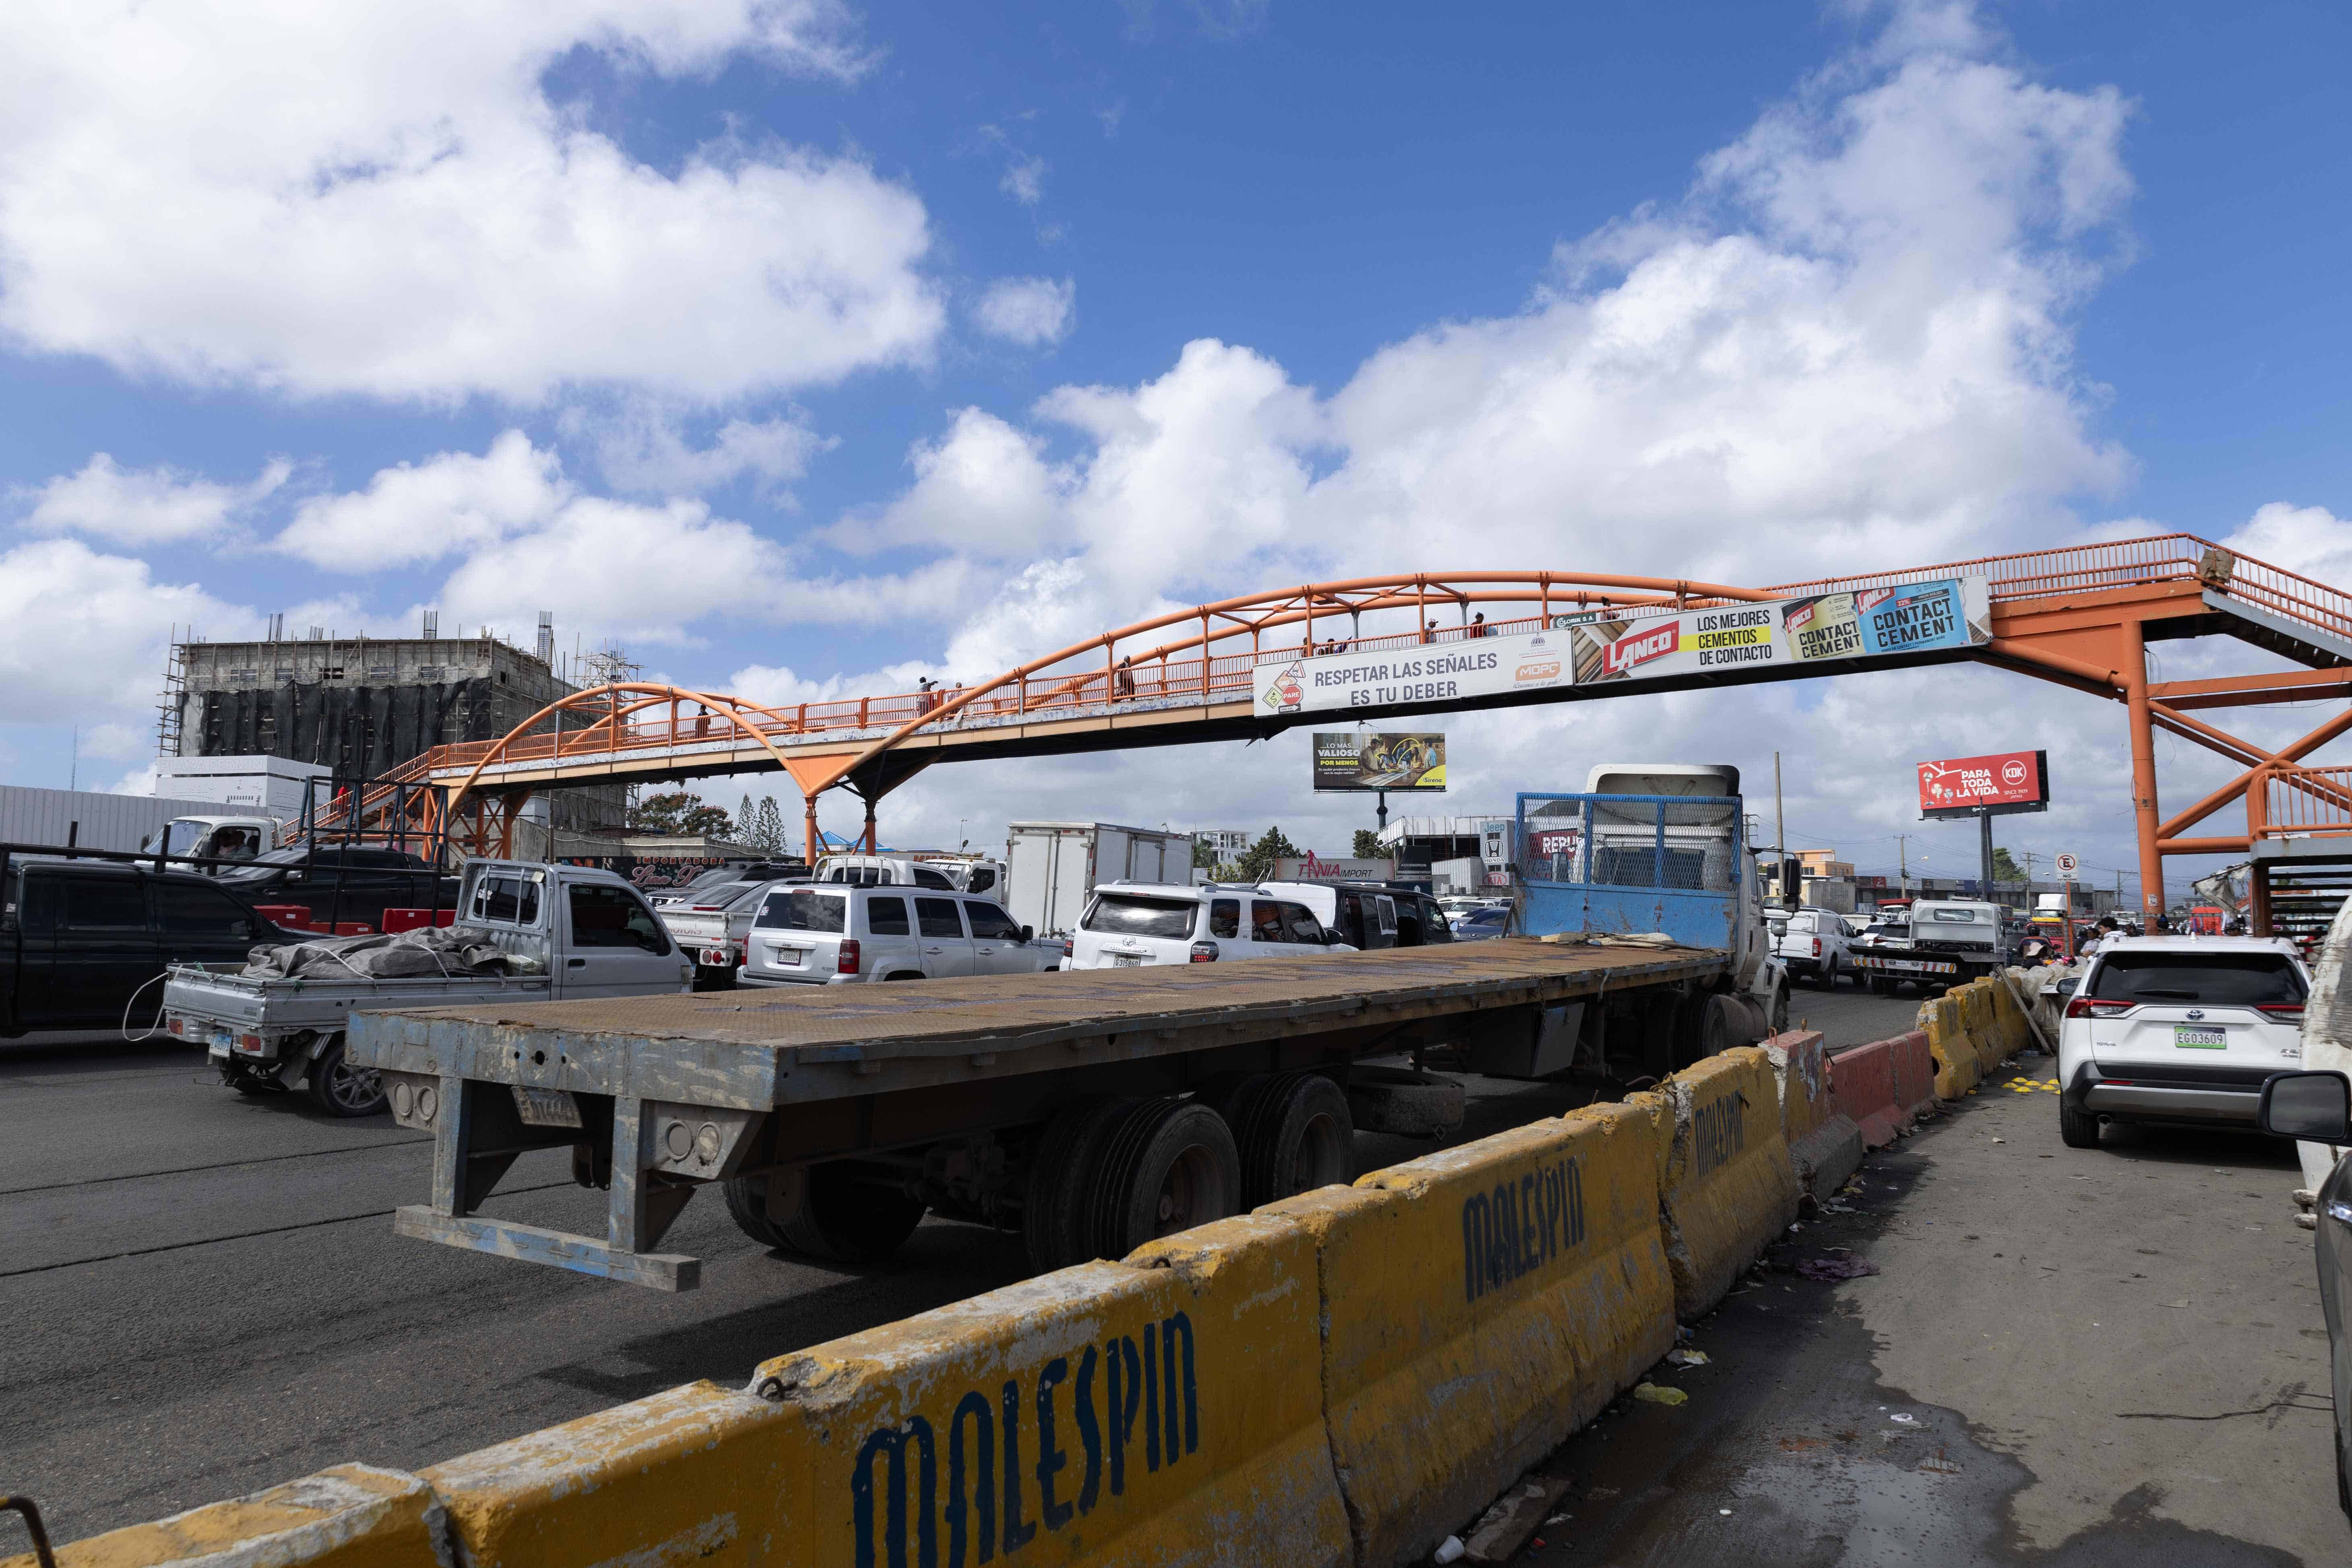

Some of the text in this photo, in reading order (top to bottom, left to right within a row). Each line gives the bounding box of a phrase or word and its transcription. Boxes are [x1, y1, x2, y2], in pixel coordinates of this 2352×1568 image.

[1897, 599, 1910, 607] 22%
[1697, 609, 1770, 632] LOS MEJORES
[1787, 608, 1811, 631] LANCO
[1873, 598, 1951, 631] CONTACT
[1699, 629, 1757, 649] CEMENTOS
[1798, 620, 1857, 646] CONTACT
[1877, 615, 1954, 647] CEMENT
[1609, 630, 1672, 671] LANCO
[1700, 645, 1772, 665] DE CONTACTO
[1802, 634, 1860, 659] CEMENT
[1315, 653, 1497, 686] RESPETAR LAS SEÑALES
[1520, 663, 1559, 676] MOPC
[1350, 680, 1457, 706] ES TU DEBER
[161, 758, 263, 772] PLAZA FERMIN
[1961, 769, 1991, 779] PARA
[2005, 767, 2023, 778] KDK
[1956, 787, 1999, 797] LA VIDA
[1961, 778, 1993, 788] TODA
[1484, 822, 1505, 833] Jeep
[637, 857, 725, 865] IMPORTADORA
[629, 865, 672, 887] Lian
[1488, 876, 1502, 885] KIA
[779, 953, 799, 962] G388004
[2178, 1033, 2223, 1044] EG03609
[1695, 1090, 1744, 1178] MALESPIN
[1463, 1155, 1584, 1303] MALESPIN
[851, 1311, 1199, 1568] MALESPIN
